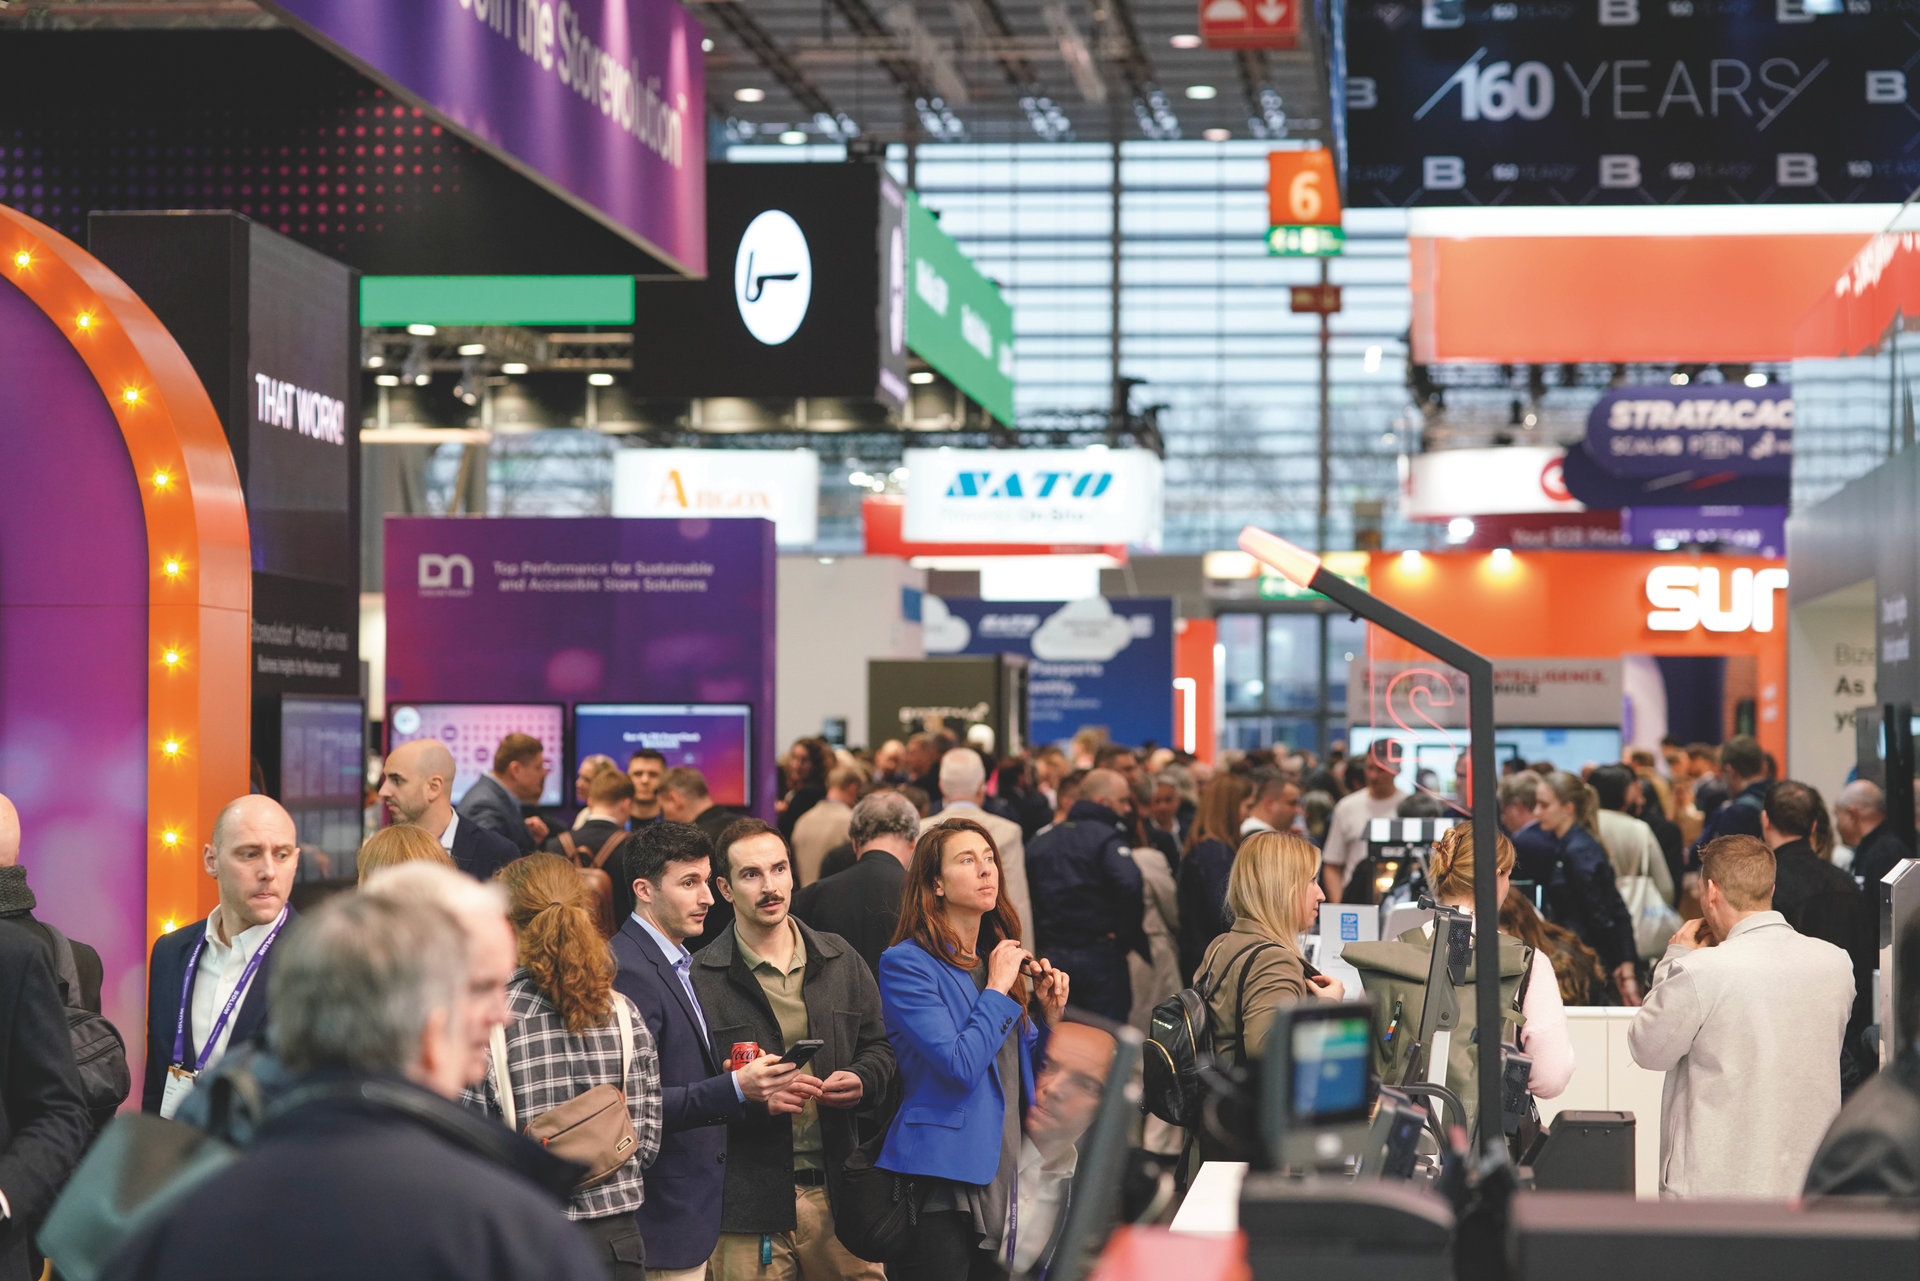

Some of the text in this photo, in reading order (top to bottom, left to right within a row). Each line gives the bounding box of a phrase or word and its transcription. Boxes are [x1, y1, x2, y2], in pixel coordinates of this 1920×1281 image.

[1563, 57, 1805, 122] YEARS
[1865, 70, 1907, 103] B
[1422, 155, 1465, 190] B
[1600, 154, 1642, 188] B
[1776, 153, 1818, 187] B
[1290, 169, 1322, 222] 6
[255, 372, 295, 430] THAT
[945, 470, 1113, 498] SATO
[492, 559, 715, 577] Top Performance for Sustainable
[498, 577, 709, 593] and Accessible Store Solutions
[1835, 676, 1864, 695] As
[223, 990, 240, 1015] SOLUM
